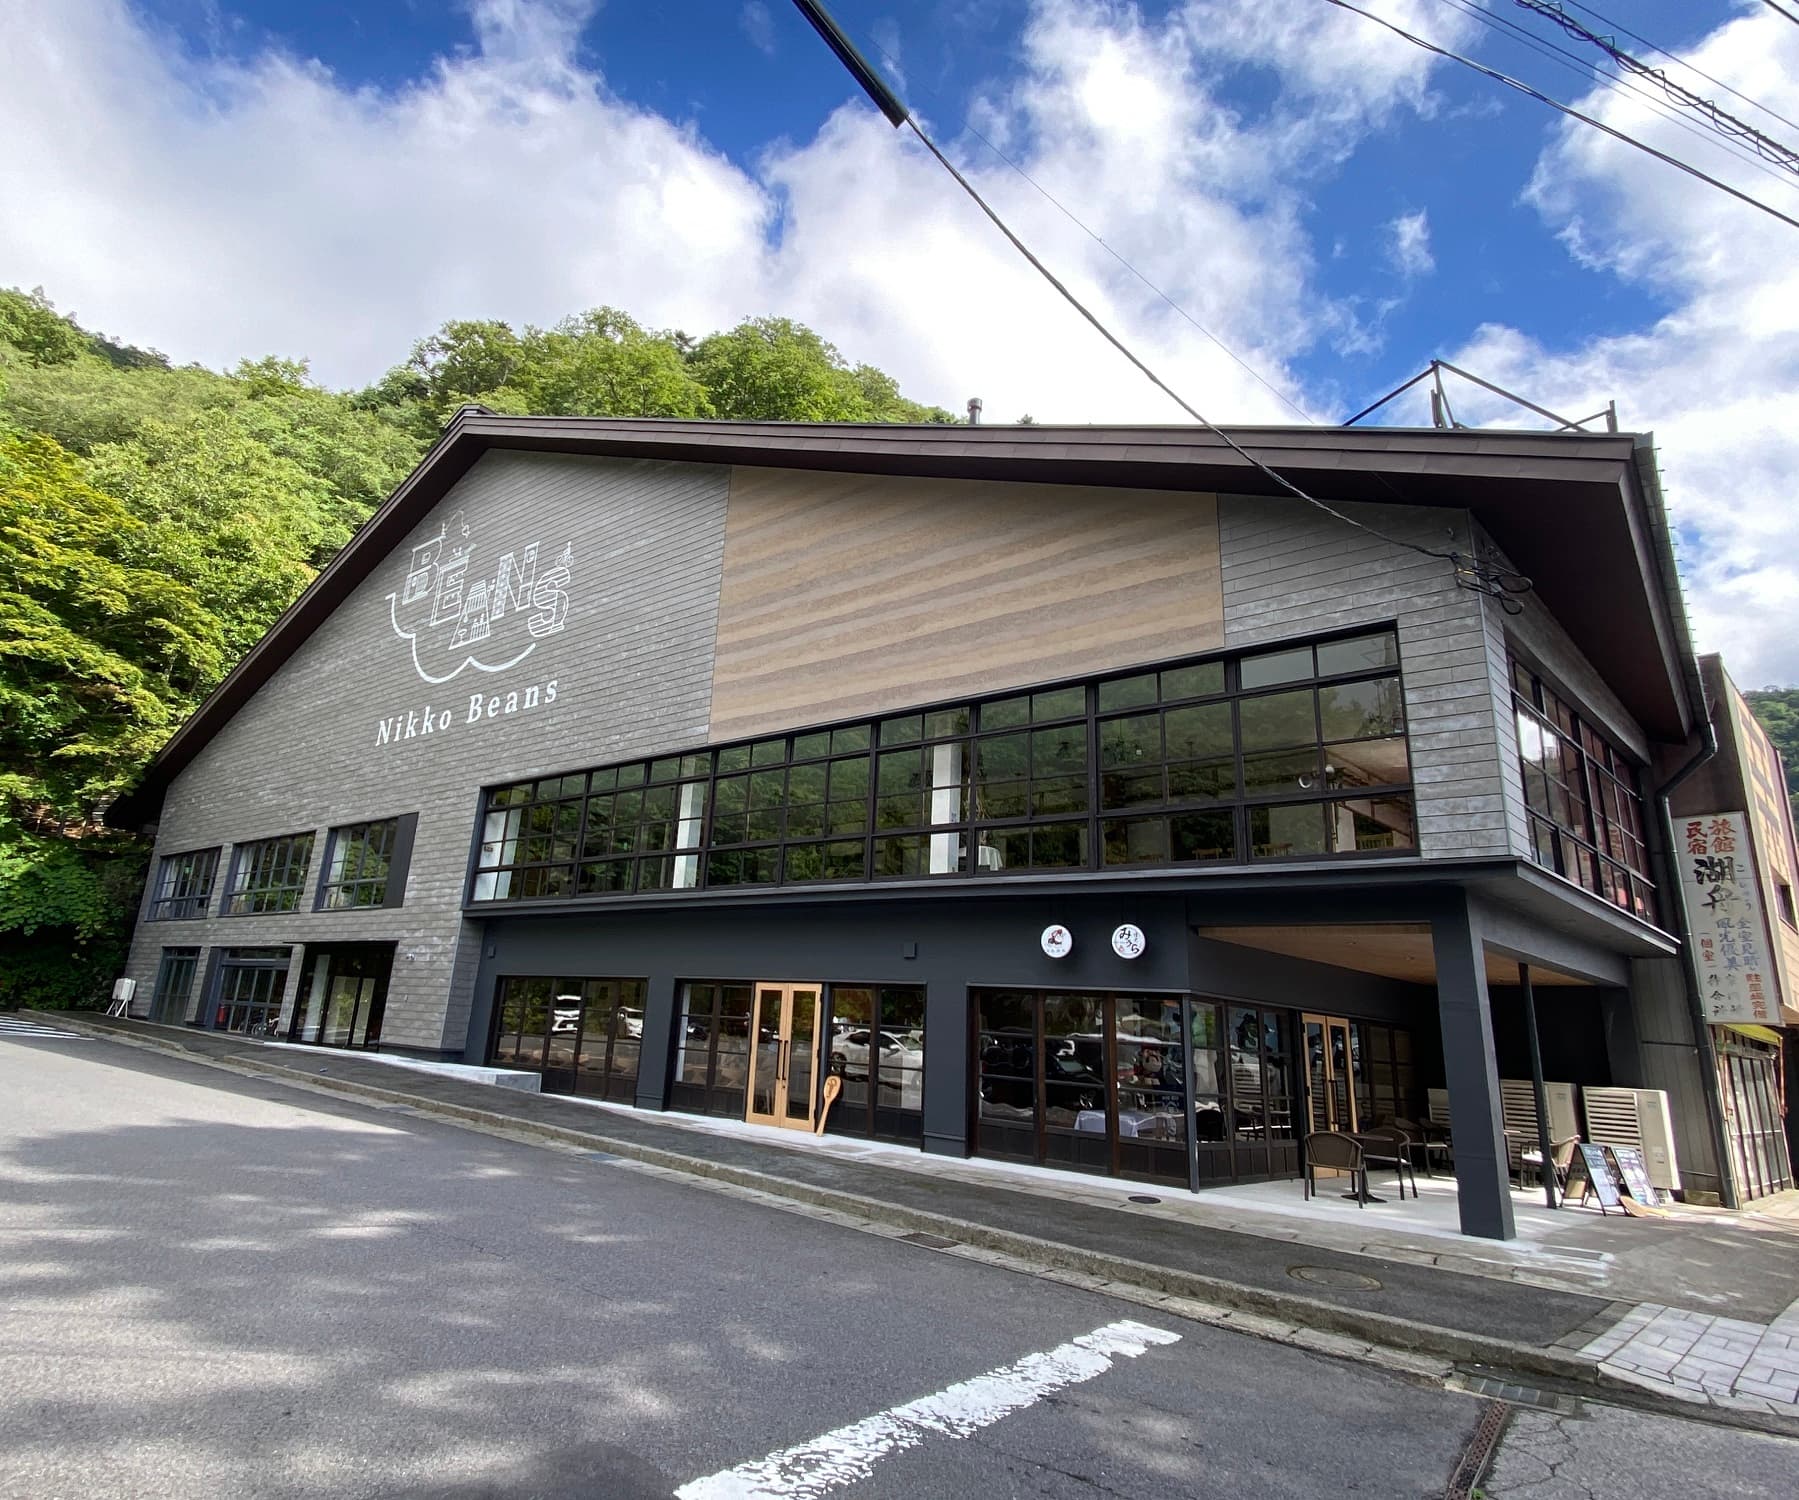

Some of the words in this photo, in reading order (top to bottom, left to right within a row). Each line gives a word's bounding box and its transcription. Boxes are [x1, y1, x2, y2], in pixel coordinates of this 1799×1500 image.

[375, 705, 452, 747] Nikko
[466, 679, 559, 724] Beans
[1686, 821, 1708, 855] 民宿
[1708, 818, 1737, 854] 旅館
